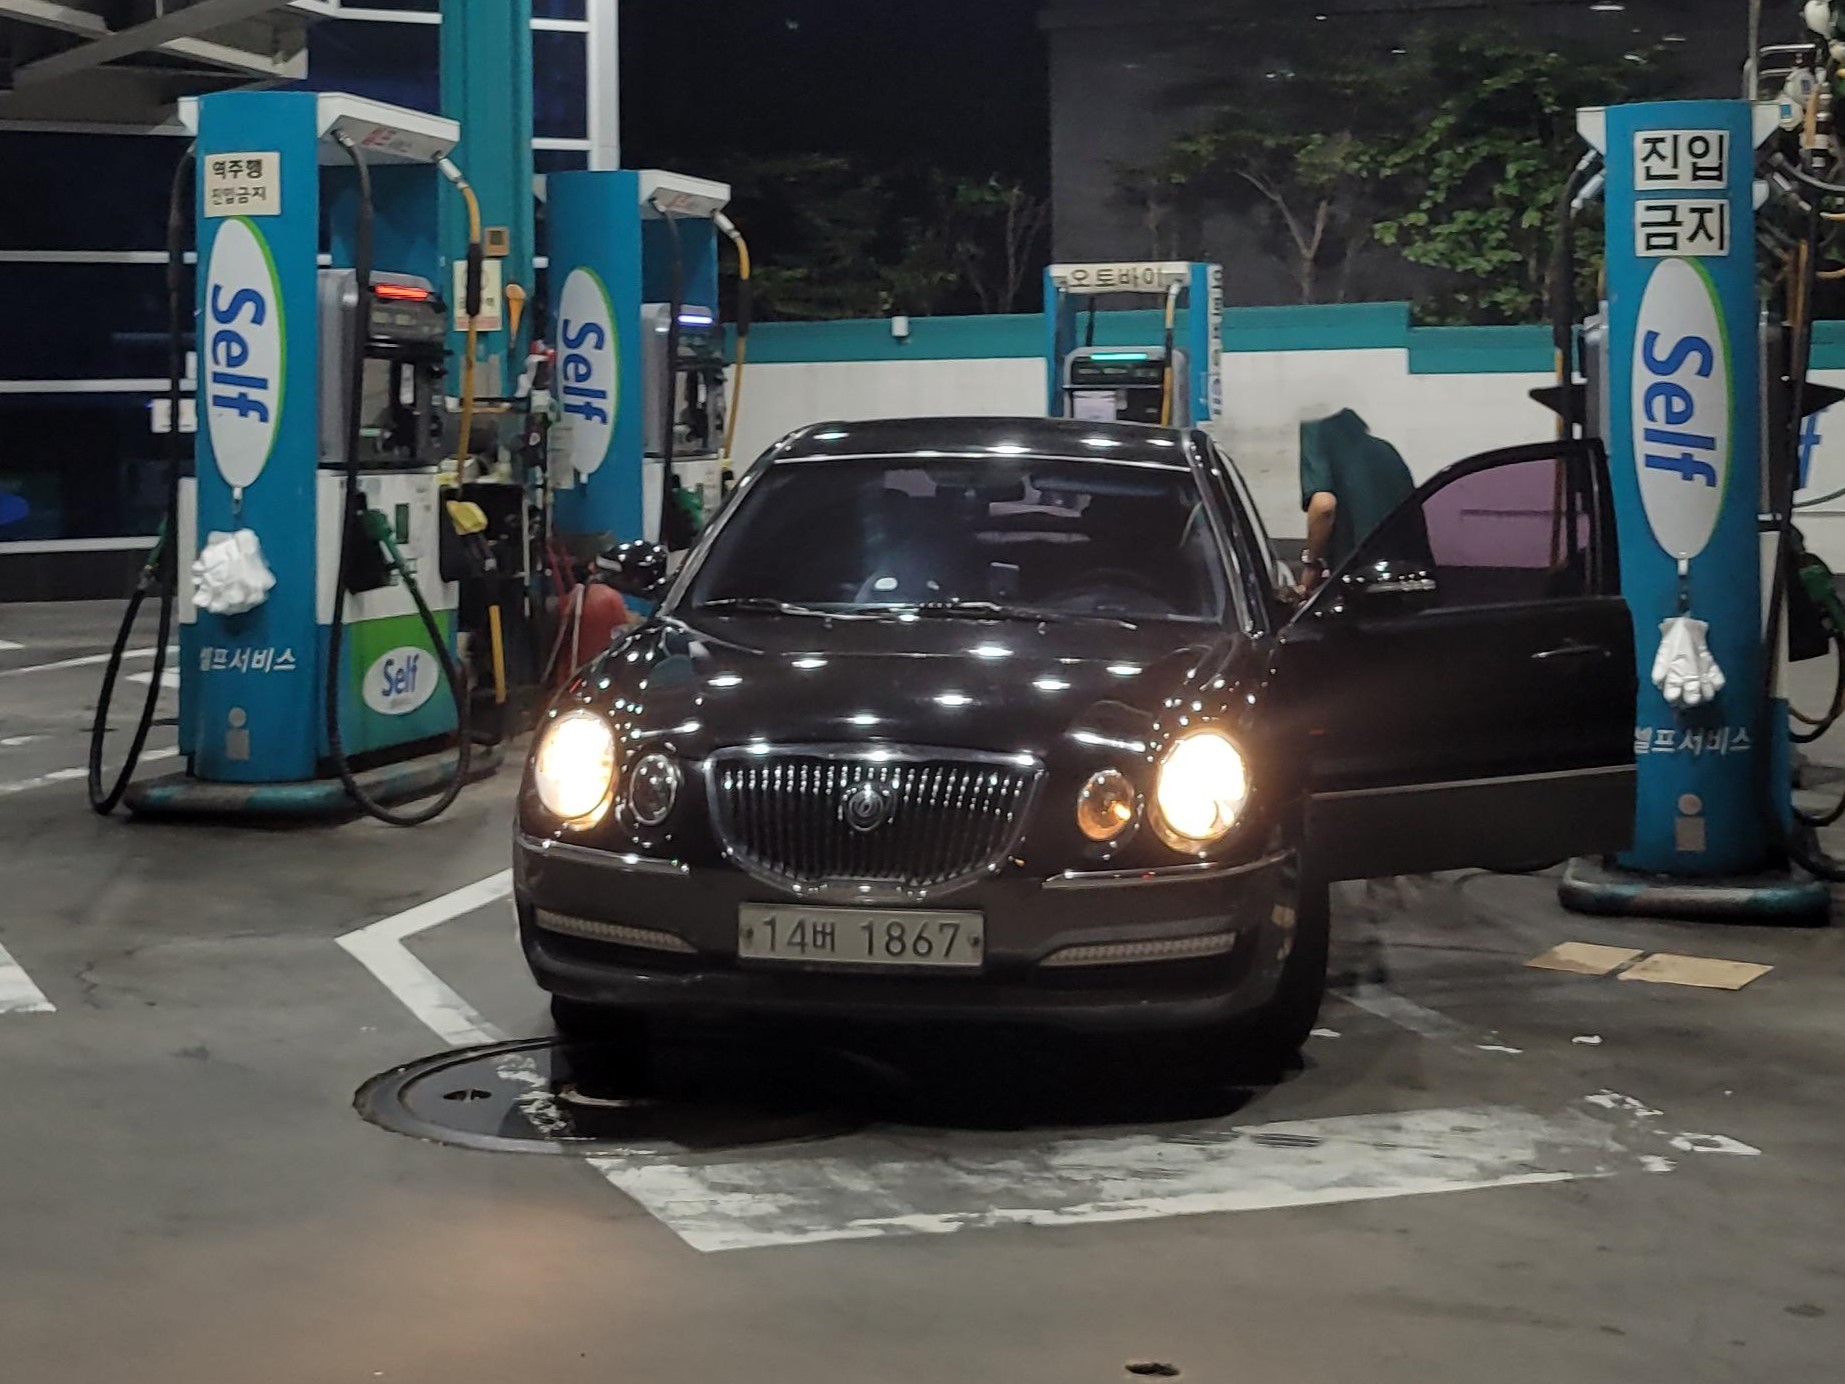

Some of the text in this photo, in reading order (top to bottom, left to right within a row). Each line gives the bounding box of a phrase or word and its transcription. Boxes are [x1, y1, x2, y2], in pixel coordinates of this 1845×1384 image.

[213, 159, 262, 179] 역주행
[1641, 134, 1725, 182] 진입
[1641, 204, 1725, 251] 금지
[1069, 266, 1161, 288] 오토바이
[211, 284, 270, 423] Self
[562, 319, 608, 425] Self
[1643, 330, 1717, 488] Self
[381, 653, 421, 697] Self
[762, 914, 961, 958] 14버 1867
